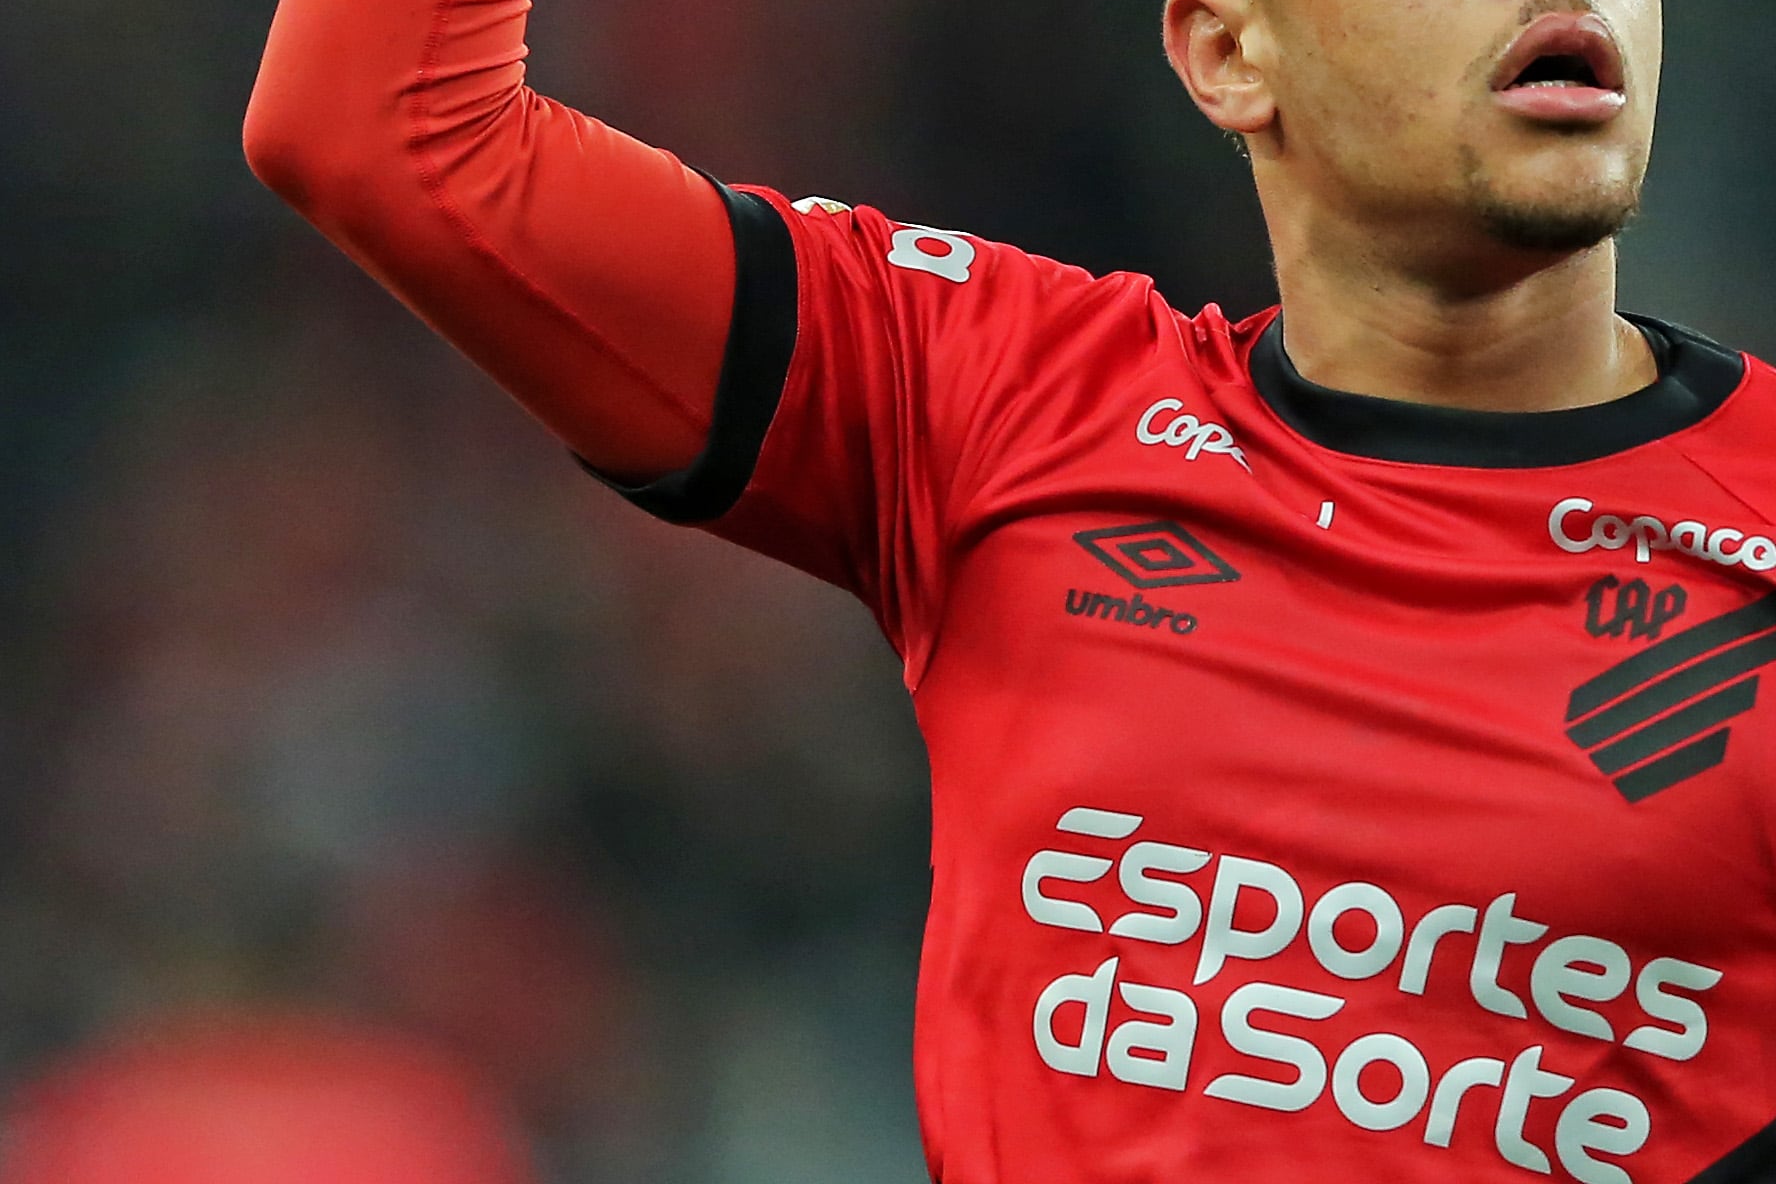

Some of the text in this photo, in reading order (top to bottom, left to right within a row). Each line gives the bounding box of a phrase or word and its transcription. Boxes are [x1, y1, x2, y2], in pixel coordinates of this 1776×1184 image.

[1065, 588, 1198, 636] umbro
[1584, 573, 1688, 642] CAP
[1021, 806, 1724, 1062] Esportes
[1033, 956, 1652, 1184] da Sorte
